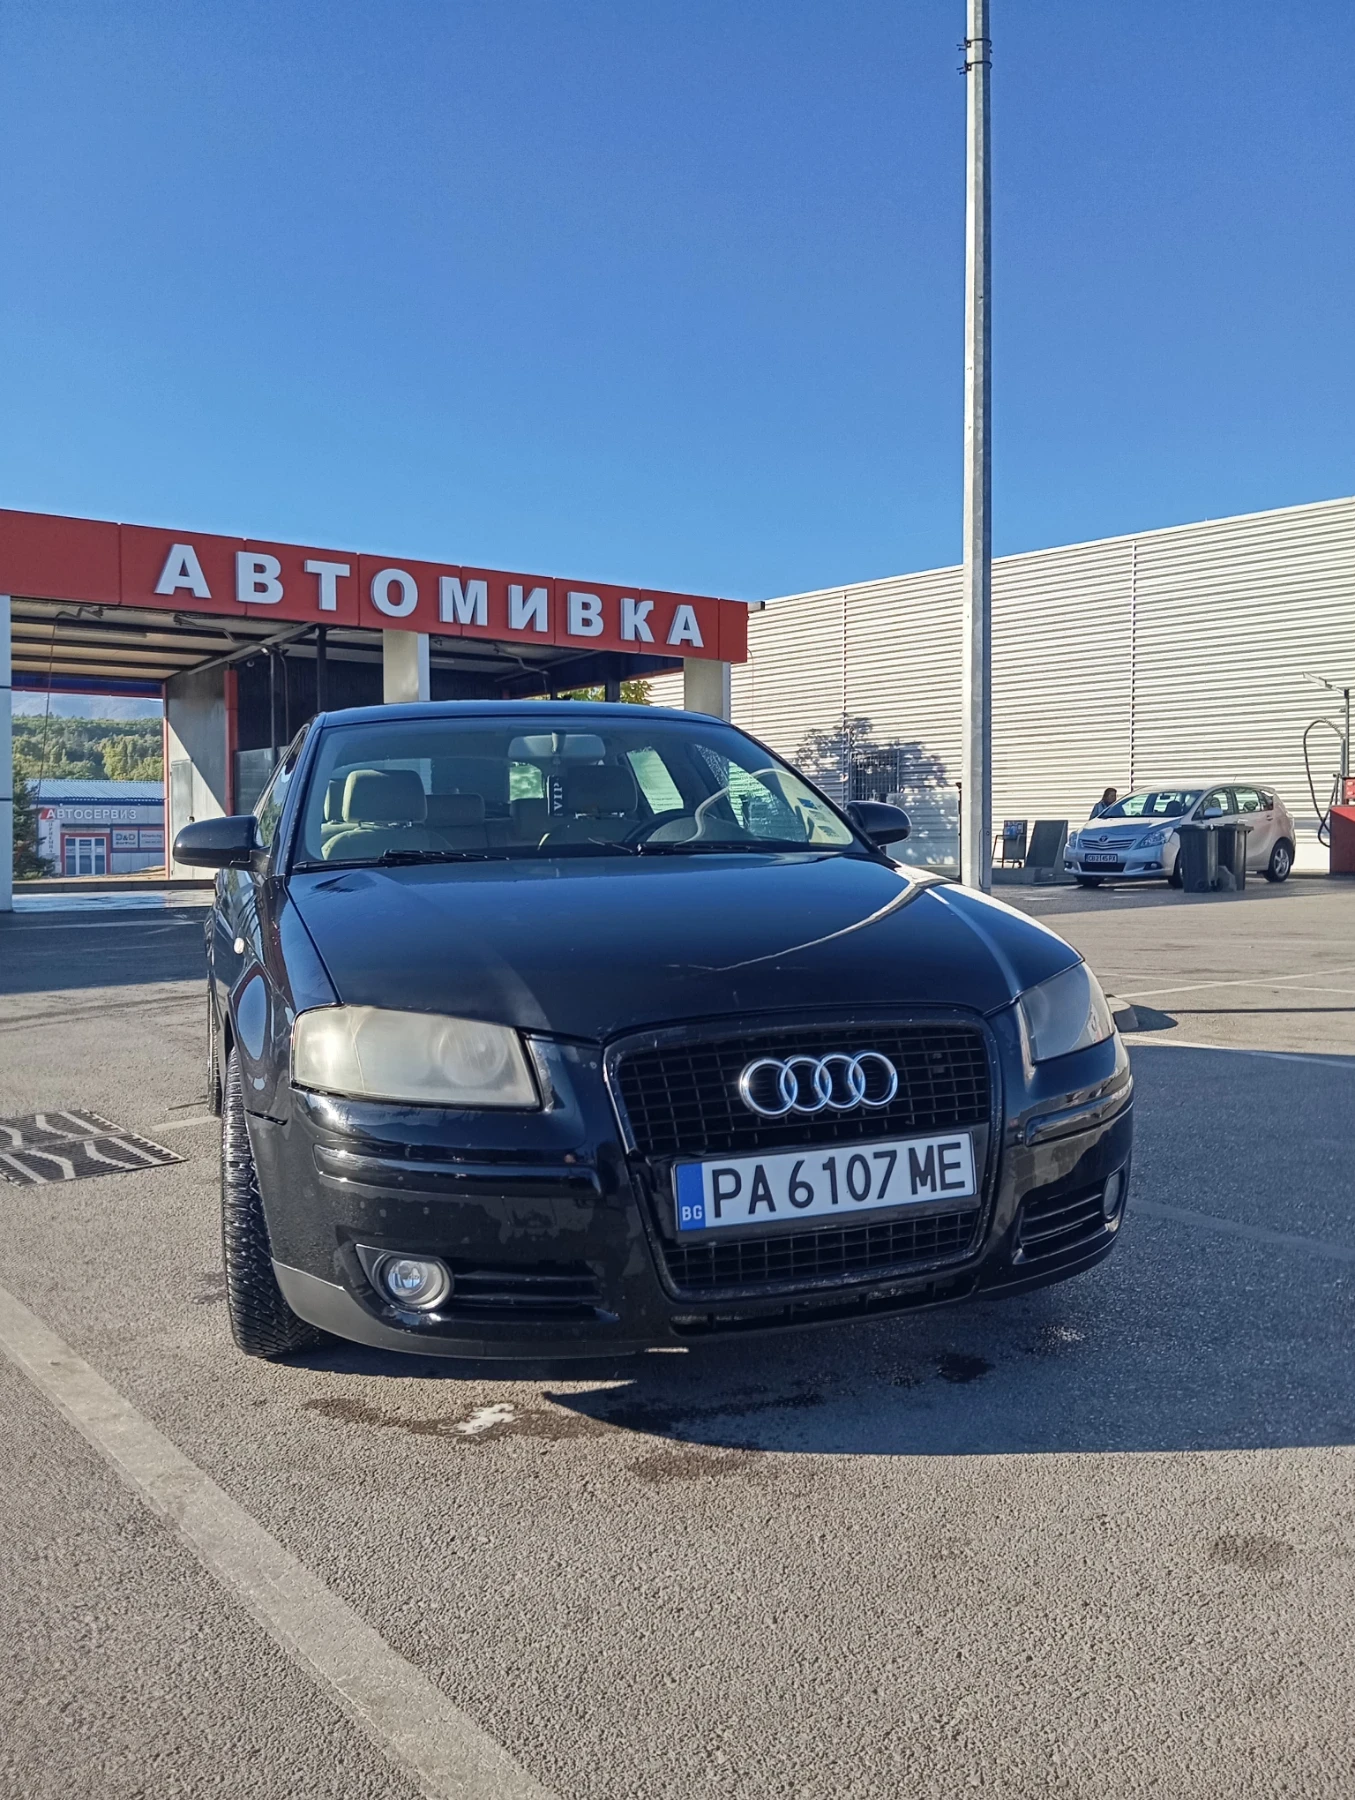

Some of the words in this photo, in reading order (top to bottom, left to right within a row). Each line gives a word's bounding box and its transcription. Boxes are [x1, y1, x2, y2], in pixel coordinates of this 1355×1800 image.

[154, 543, 704, 649] АВТОМИВКА
[553, 782, 563, 811] VIP
[46, 808, 137, 819] АВТОСЕРВИЗ
[682, 1204, 703, 1221] BG
